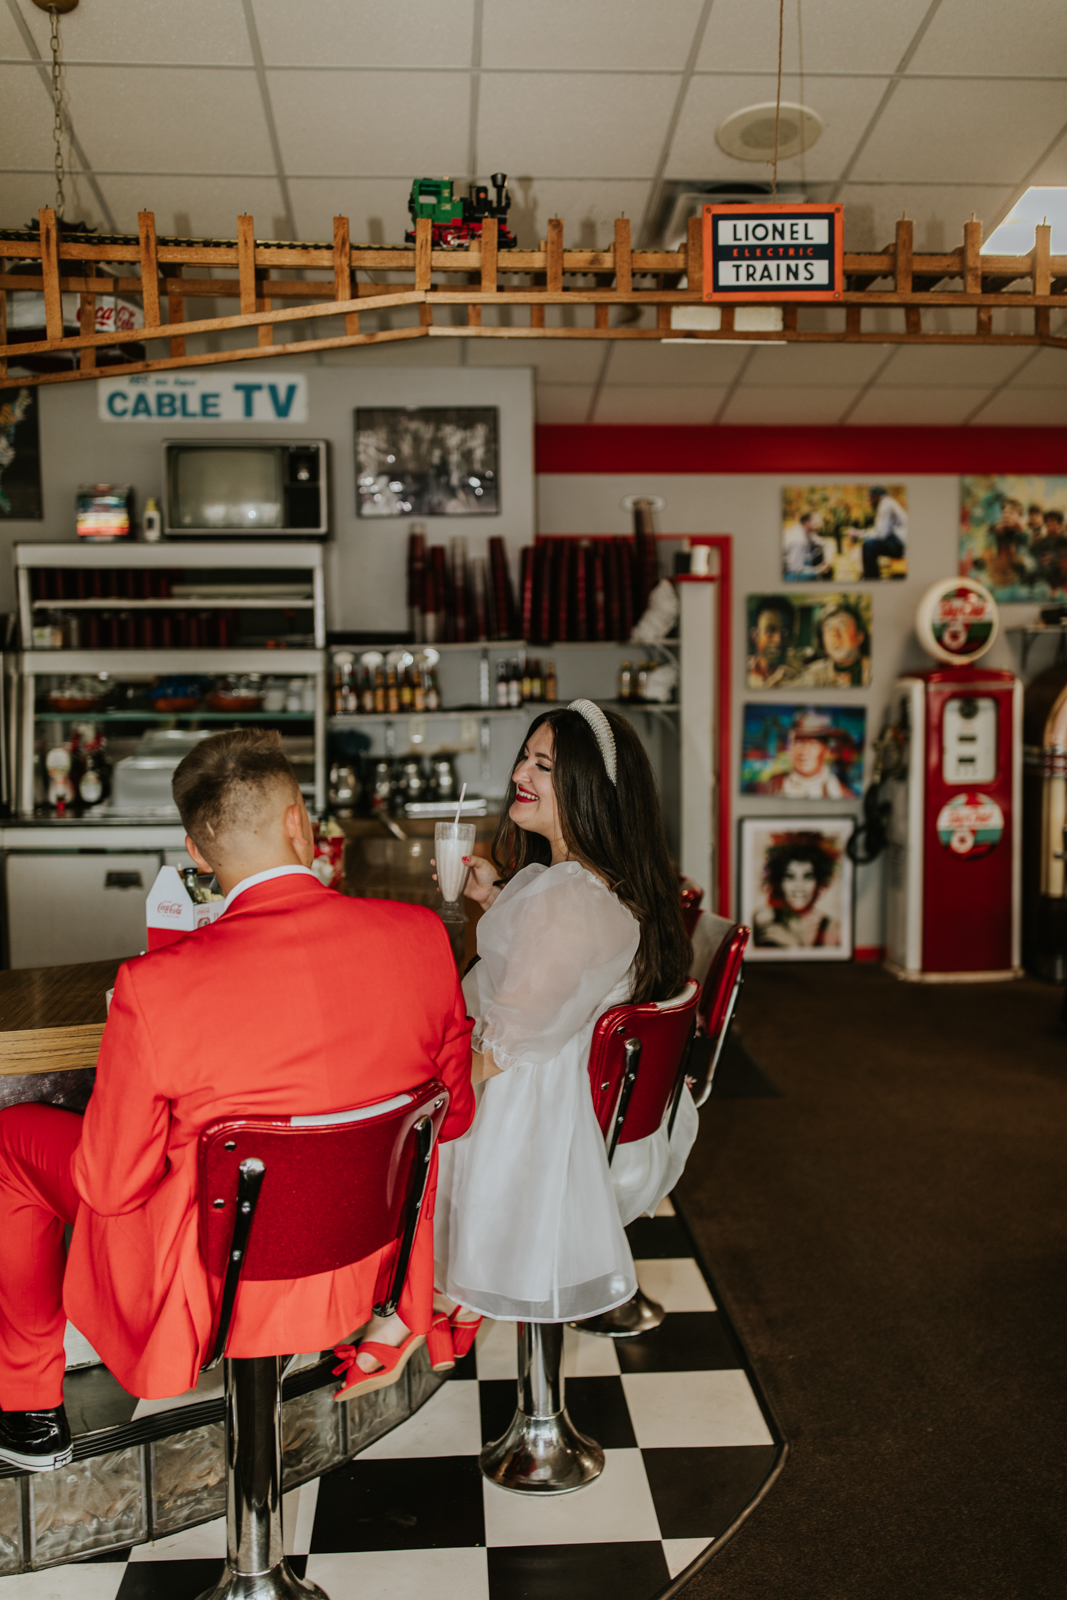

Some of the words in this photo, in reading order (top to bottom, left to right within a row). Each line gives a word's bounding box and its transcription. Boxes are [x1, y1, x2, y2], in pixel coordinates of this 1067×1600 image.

[733, 223, 814, 241] LIONEL
[732, 247, 814, 257] ELECTRIC
[732, 262, 814, 282] TRAINS
[107, 391, 221, 418] CABLE
[233, 383, 298, 418] TV
